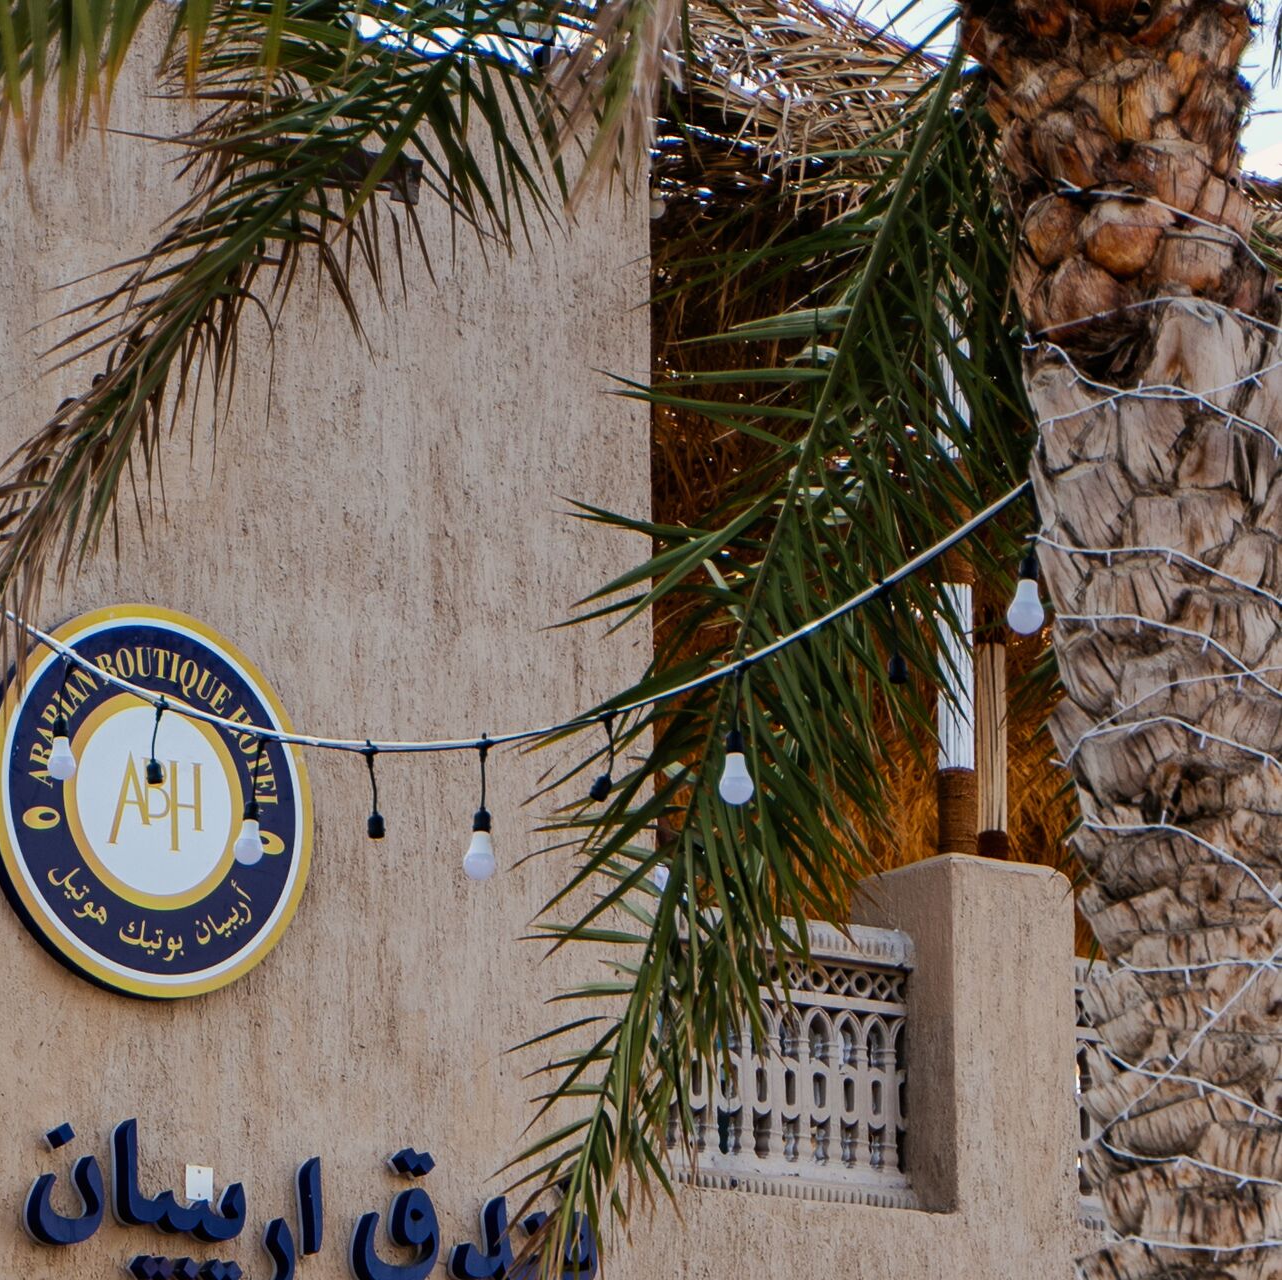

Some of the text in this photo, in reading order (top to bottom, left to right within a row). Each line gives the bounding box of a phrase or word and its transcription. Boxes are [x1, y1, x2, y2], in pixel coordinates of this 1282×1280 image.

[95, 646, 233, 715] BOUTIQUE
[226, 703, 279, 814] HOTEL
[106, 751, 204, 852] ABH
[47, 866, 252, 962] أريبيان بوتيك هوتيل
